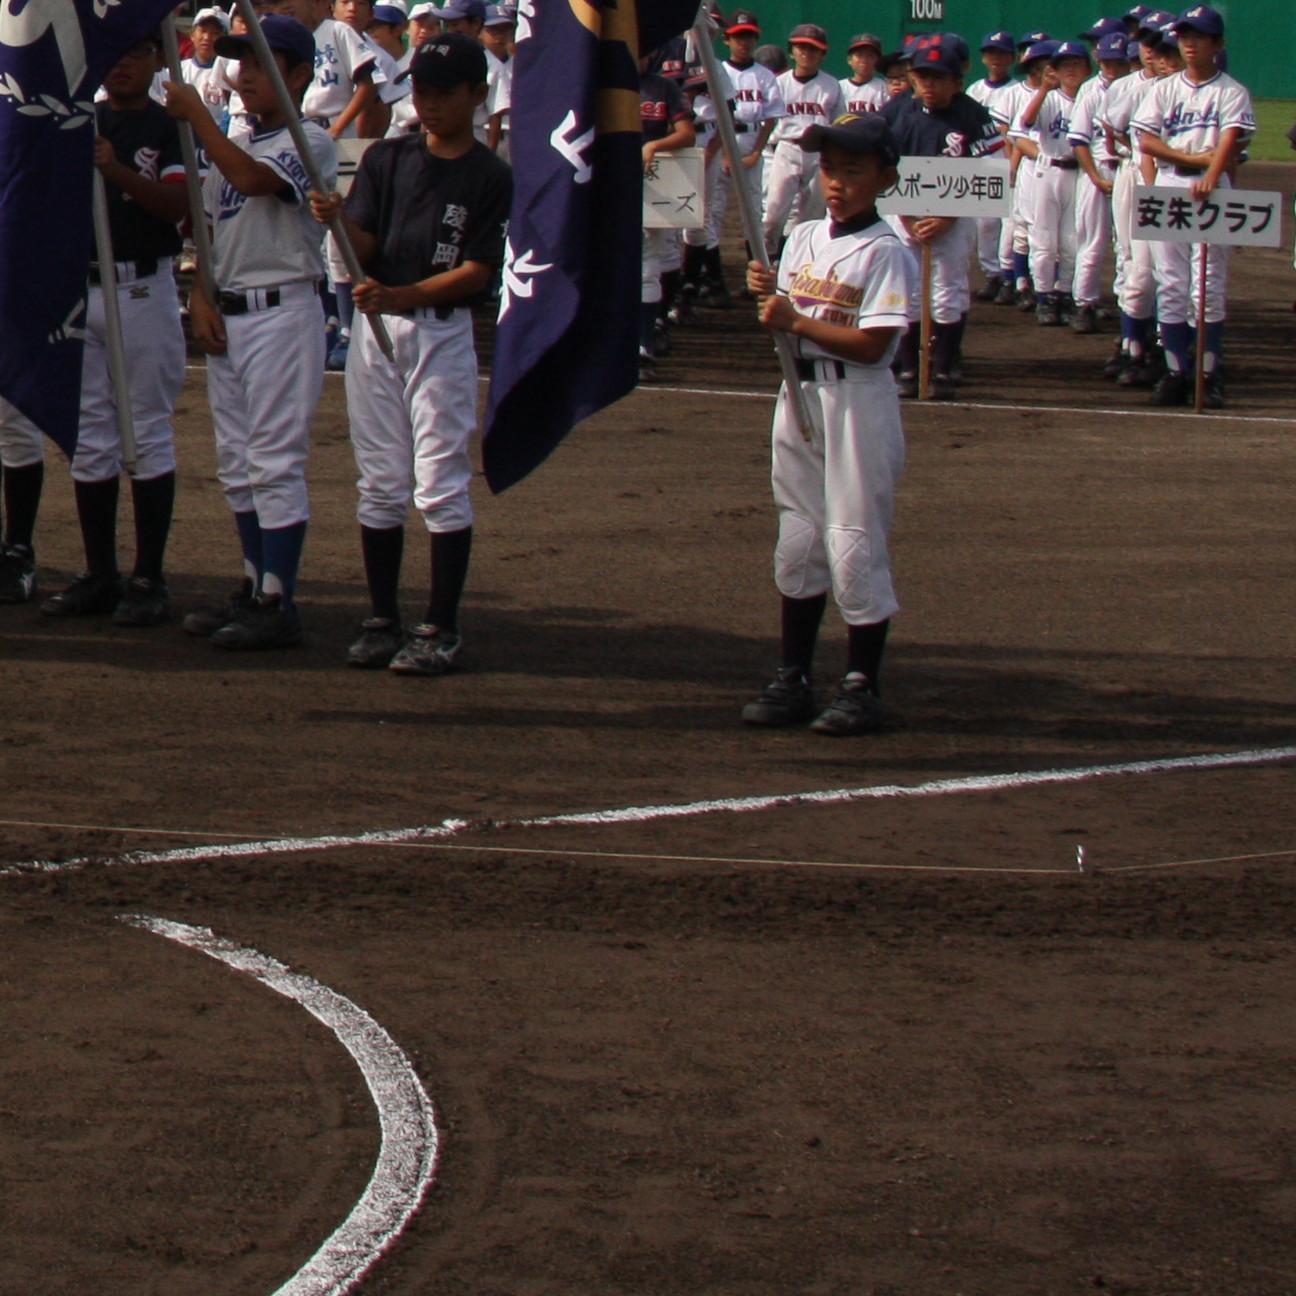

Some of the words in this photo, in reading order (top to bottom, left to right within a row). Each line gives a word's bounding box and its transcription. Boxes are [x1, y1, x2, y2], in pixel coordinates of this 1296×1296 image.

[876, 172, 1004, 201] スポーツ少年団
[1136, 195, 1275, 234] 安朱クラブ
